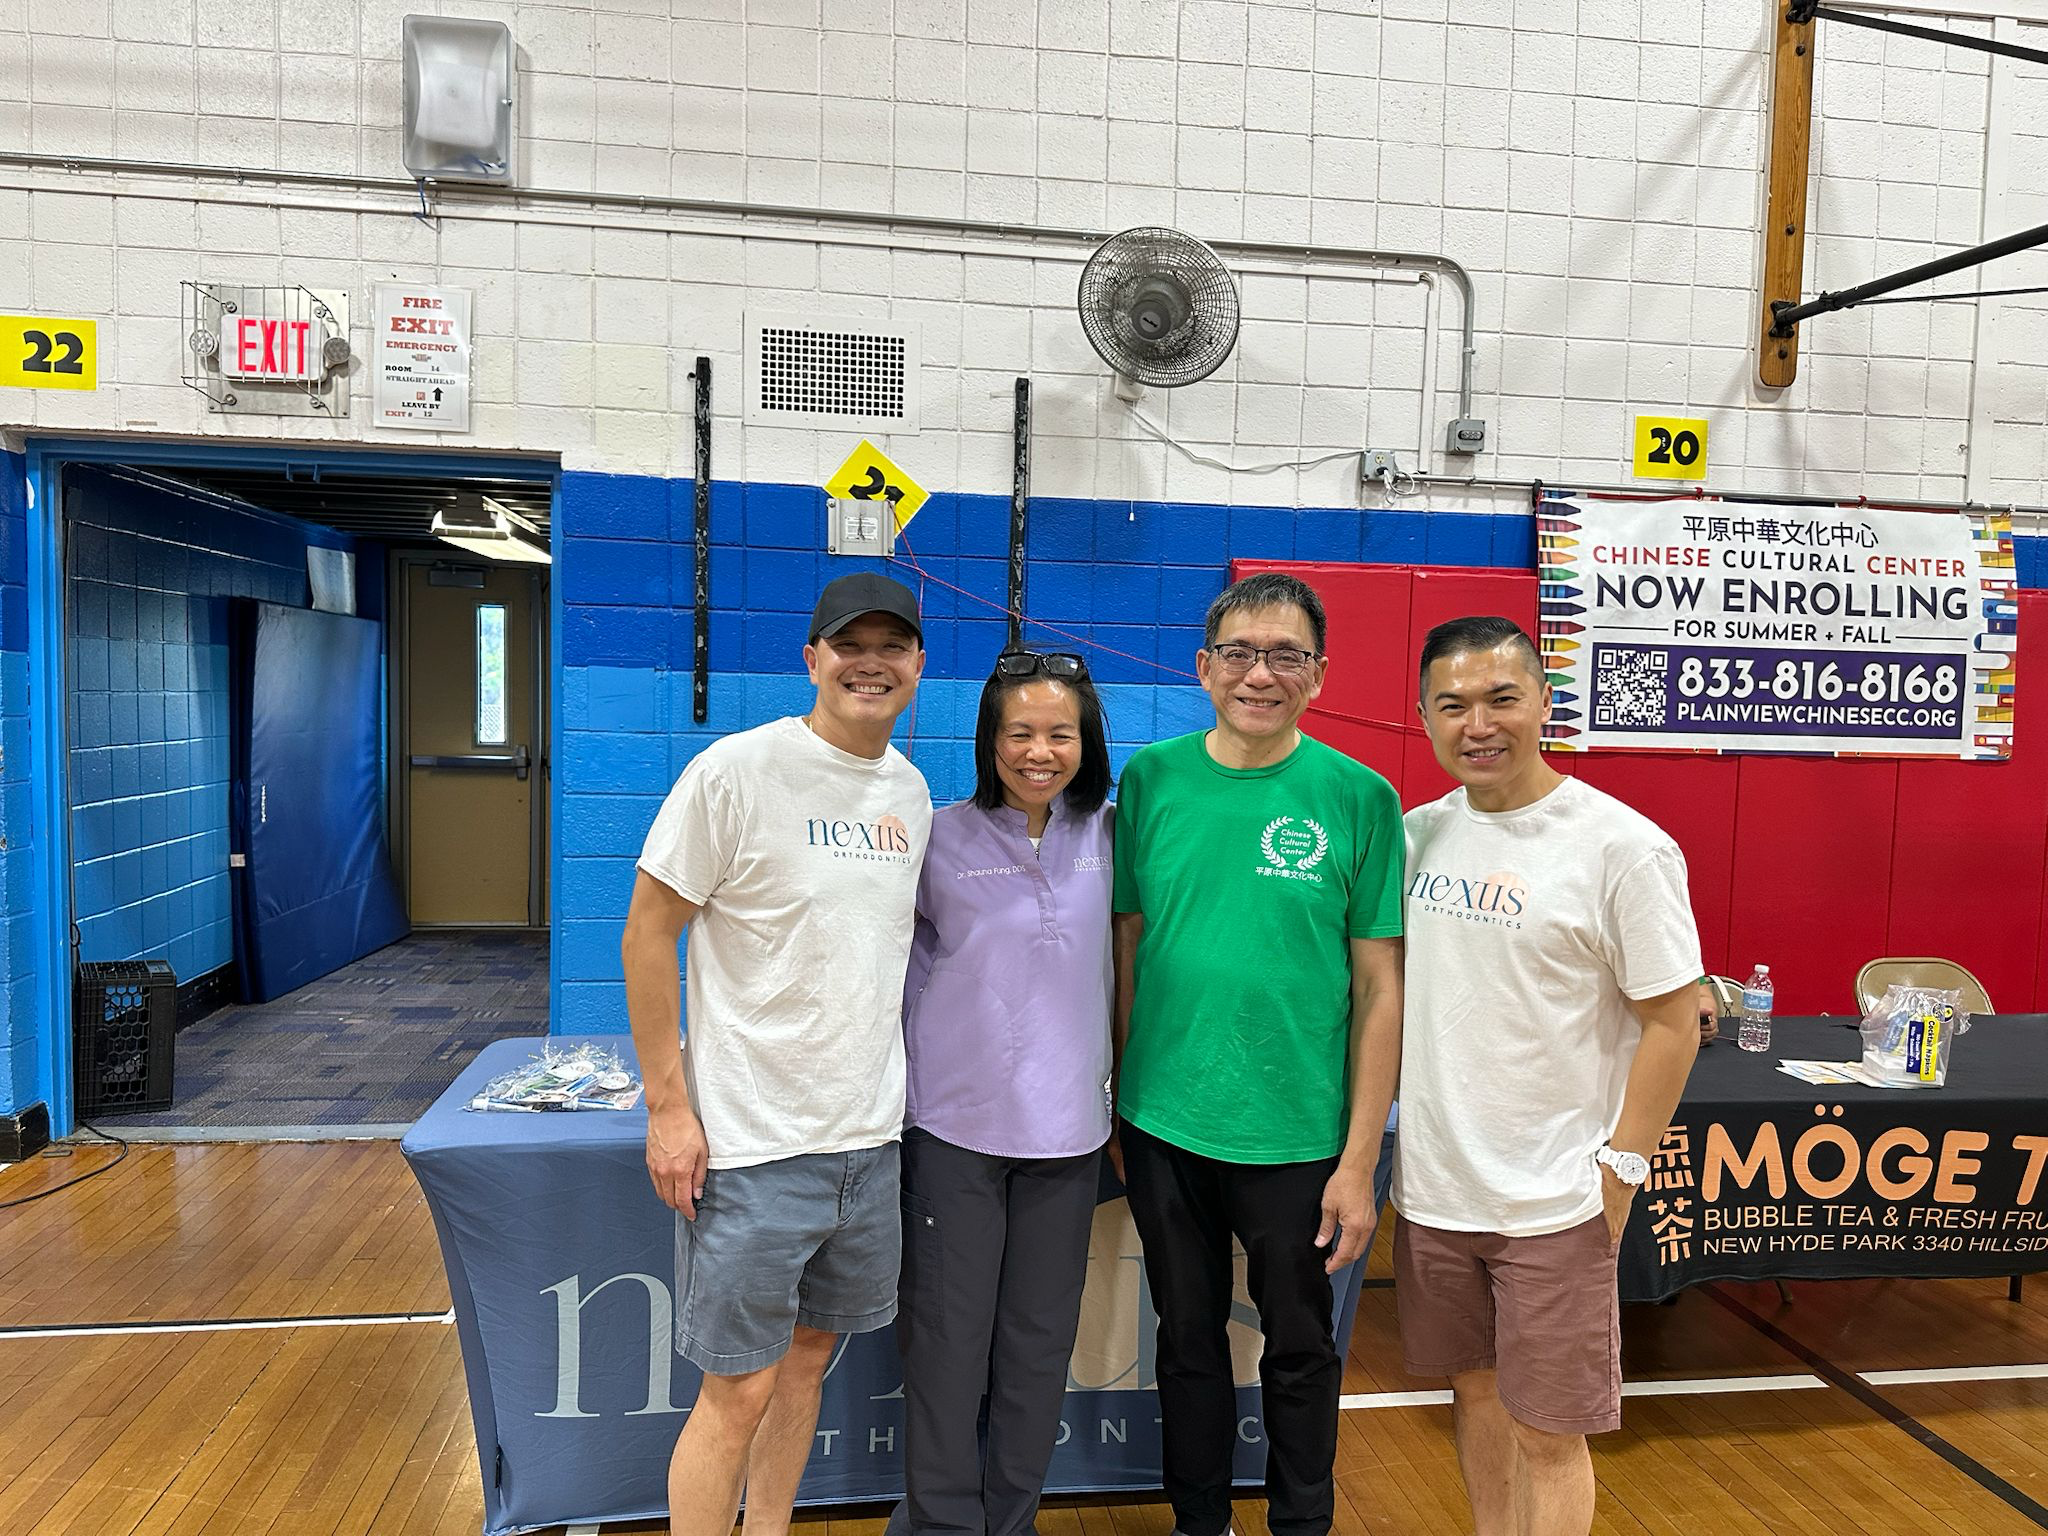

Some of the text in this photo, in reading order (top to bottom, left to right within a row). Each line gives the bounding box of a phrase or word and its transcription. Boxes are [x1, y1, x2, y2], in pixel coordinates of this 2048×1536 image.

[402, 297, 442, 310] FIRE
[391, 316, 454, 335] EXIT
[22, 329, 84, 375] 22
[237, 318, 309, 375] EXIT
[386, 340, 458, 352] EMERGENCY
[385, 365, 412, 373] ROOM
[385, 375, 427, 384] STRAIGHT
[402, 401, 427, 409] LEAVE
[1647, 427, 1700, 466] 20
[1682, 514, 1879, 549] 平原中華文化中心
[1592, 545, 1967, 577] CHINESE CULTURAL CENTER
[1596, 572, 1968, 620] NOW ENROLLING
[1673, 619, 1717, 638] FOR
[1724, 621, 1818, 642] SUMMER
[1842, 625, 1892, 644] FALL
[1677, 656, 1959, 704] 833-816-8168
[1677, 702, 1957, 727] PLAINVIEWCHINESECC.ORG
[806, 818, 909, 854] nexus
[1279, 837, 1312, 848] Cultural
[1280, 828, 1312, 839] Chinese
[833, 850, 911, 864] ORTHODONTICS
[1073, 855, 1109, 868] nexus
[1280, 846, 1307, 855] Center
[1406, 871, 1525, 916] nexus
[1424, 904, 1521, 930] ORTHODONTICS
[1924, 1021, 1936, 1075] Cocktail Napkins
[1701, 1104, 1990, 1204] MÖGE
[1704, 1205, 1814, 1231] BUBBLE
[1822, 1205, 1875, 1227] TEA
[1882, 1206, 1900, 1227] &
[1908, 1207, 1998, 1230] FRESH
[1703, 1236, 1763, 1256] NEW
[1769, 1234, 1836, 1252] HYDE
[1842, 1234, 1907, 1251] PARK
[1912, 1235, 1963, 1251] 3340
